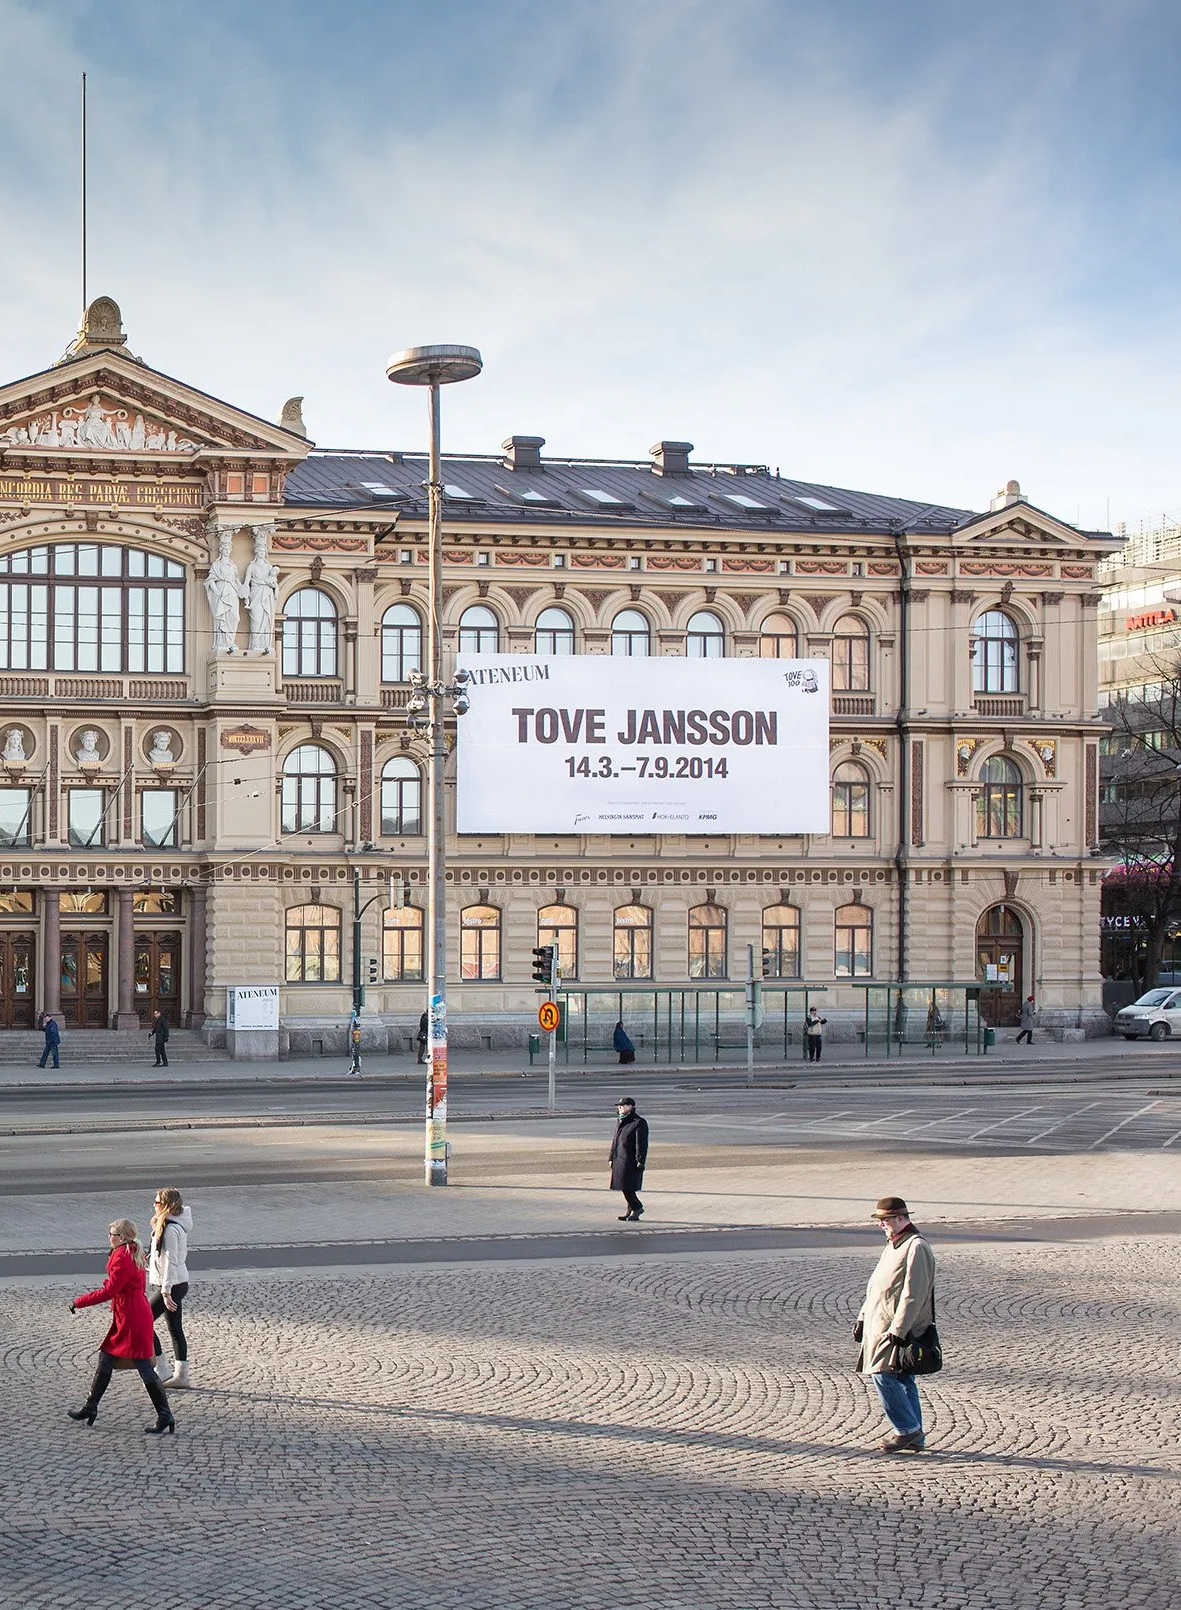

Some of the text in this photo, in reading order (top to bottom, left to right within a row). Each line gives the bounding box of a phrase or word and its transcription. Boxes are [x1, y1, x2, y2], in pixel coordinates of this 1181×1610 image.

[58, 483, 83, 501] RES
[136, 487, 200, 505] CRESCUNT
[468, 664, 550, 686] ATENEUM
[783, 670, 803, 681] TOVE
[788, 680, 801, 688] 100
[511, 707, 778, 746] TOVE JANSSON
[237, 988, 277, 999] ATENEUM
